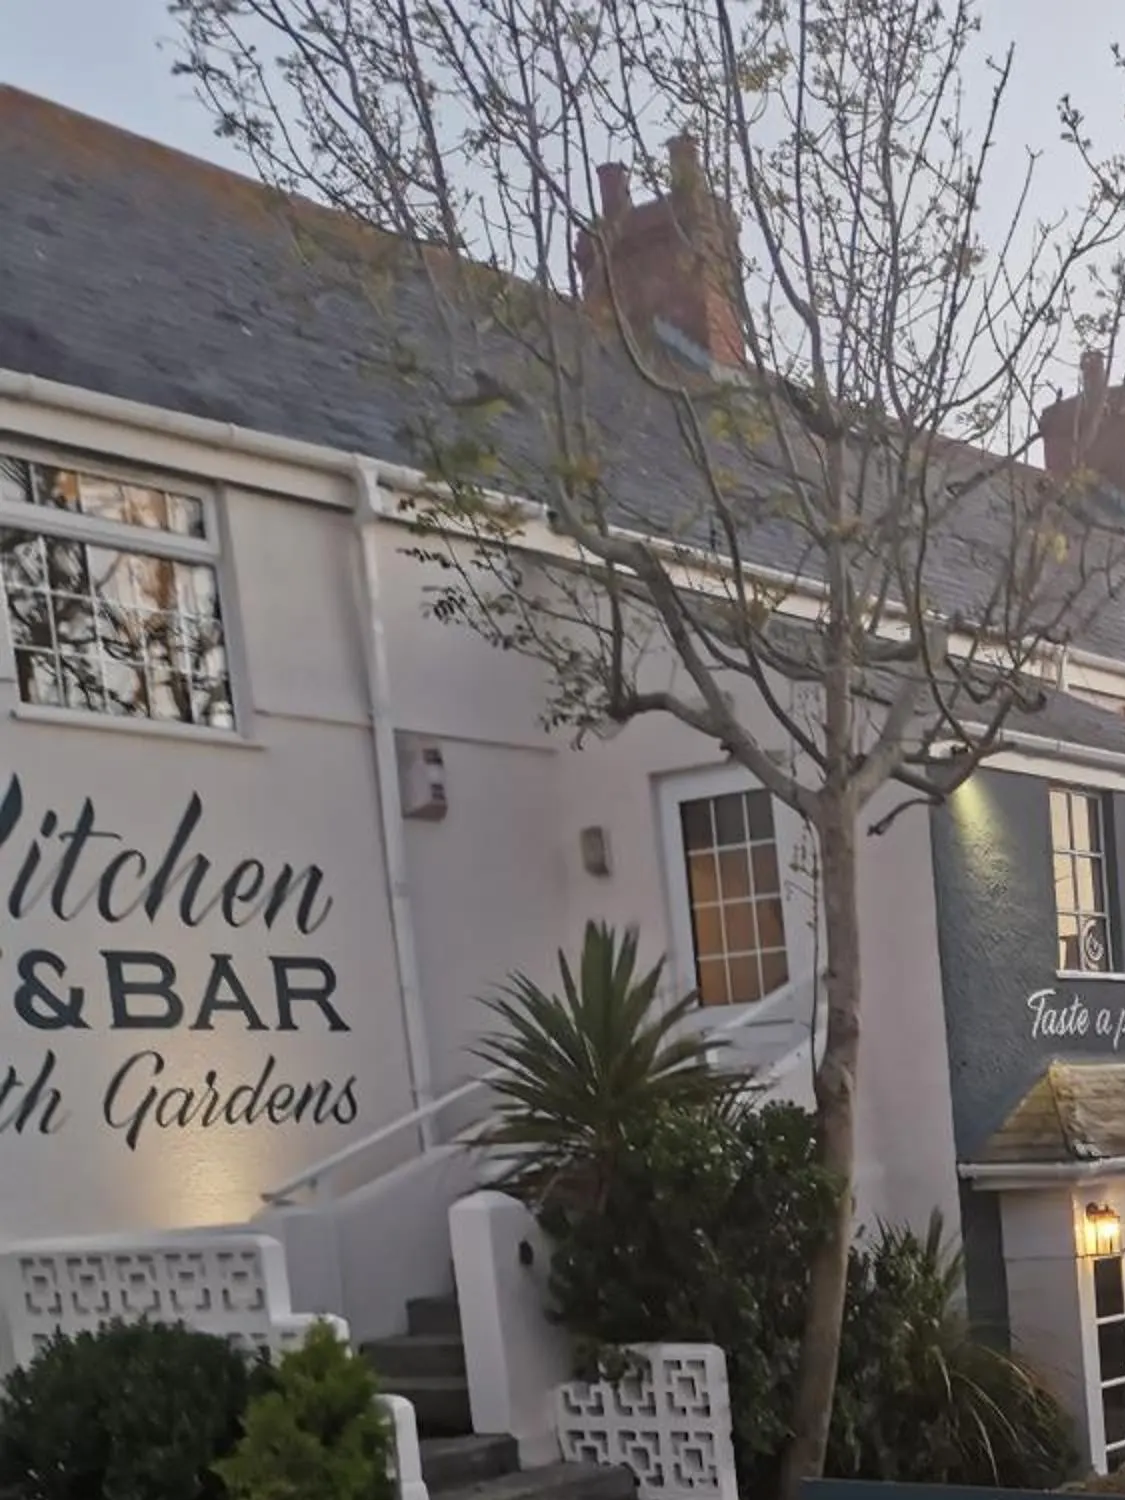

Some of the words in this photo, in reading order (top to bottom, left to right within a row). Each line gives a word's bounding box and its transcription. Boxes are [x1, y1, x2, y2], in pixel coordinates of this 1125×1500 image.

[0, 773, 334, 935] itchen
[14, 948, 93, 1030] &
[100, 950, 352, 1032] BAR
[1027, 989, 1089, 1038] Taste
[1096, 1007, 1112, 1035] a
[104, 1050, 359, 1151] Gardens
